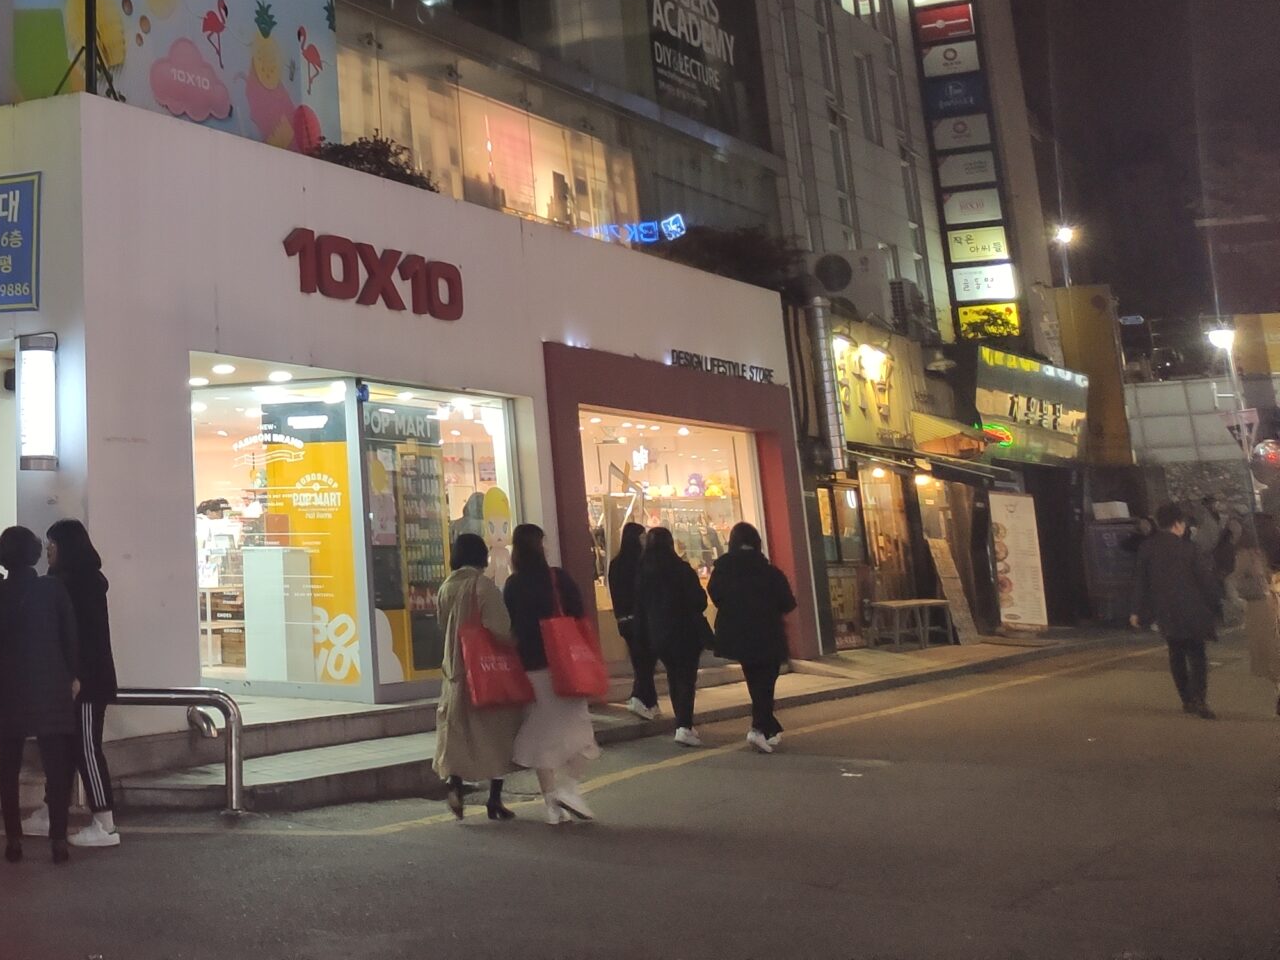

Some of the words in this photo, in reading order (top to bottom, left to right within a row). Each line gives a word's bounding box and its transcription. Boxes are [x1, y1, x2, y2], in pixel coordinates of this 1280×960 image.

[170, 68, 210, 90] 10X10
[0, 229, 23, 249] 6층
[282, 227, 464, 321] 10X10
[671, 349, 702, 371] DESIGN
[703, 355, 746, 378] LIFESTYLE
[748, 365, 774, 383] STORE
[395, 414, 432, 439] MART
[314, 492, 342, 507] MART
